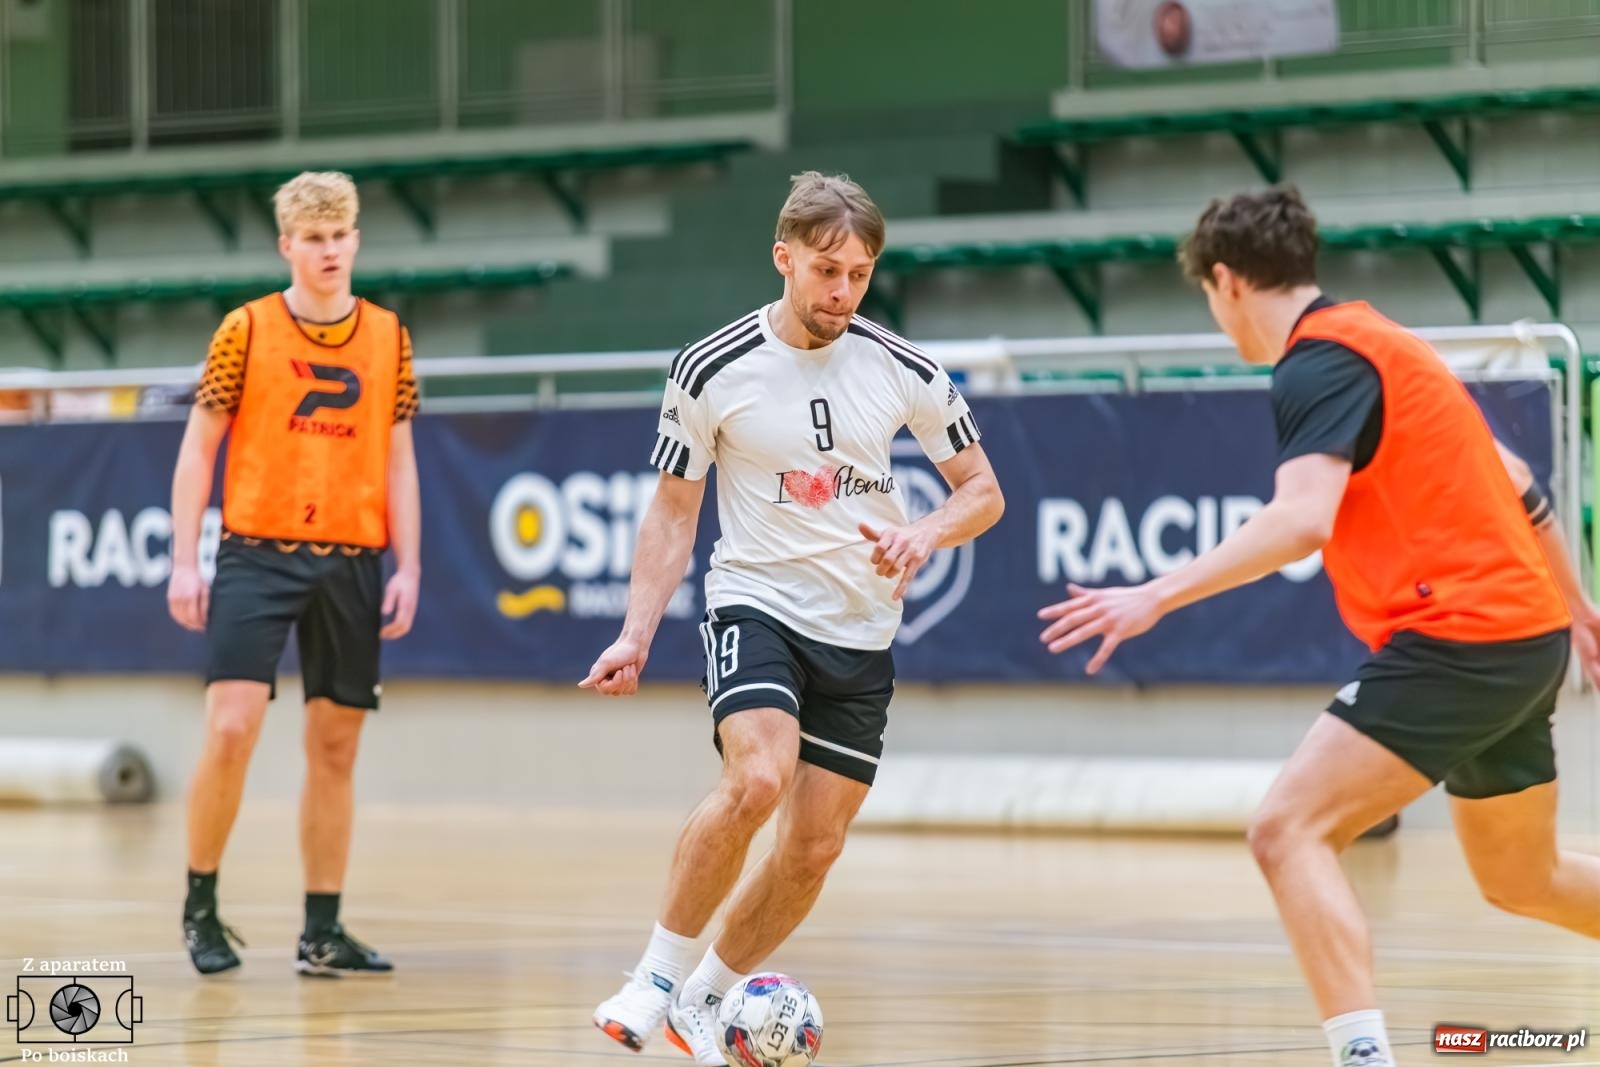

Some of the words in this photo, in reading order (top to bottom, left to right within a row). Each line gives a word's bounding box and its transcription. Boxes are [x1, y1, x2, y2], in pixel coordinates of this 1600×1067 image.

[288, 416, 357, 439] PATRICK
[810, 398, 834, 452] 9
[304, 503, 317, 525] 2
[489, 471, 696, 580] OSi
[720, 625, 740, 678] 9
[767, 995, 798, 1052] SELECT
